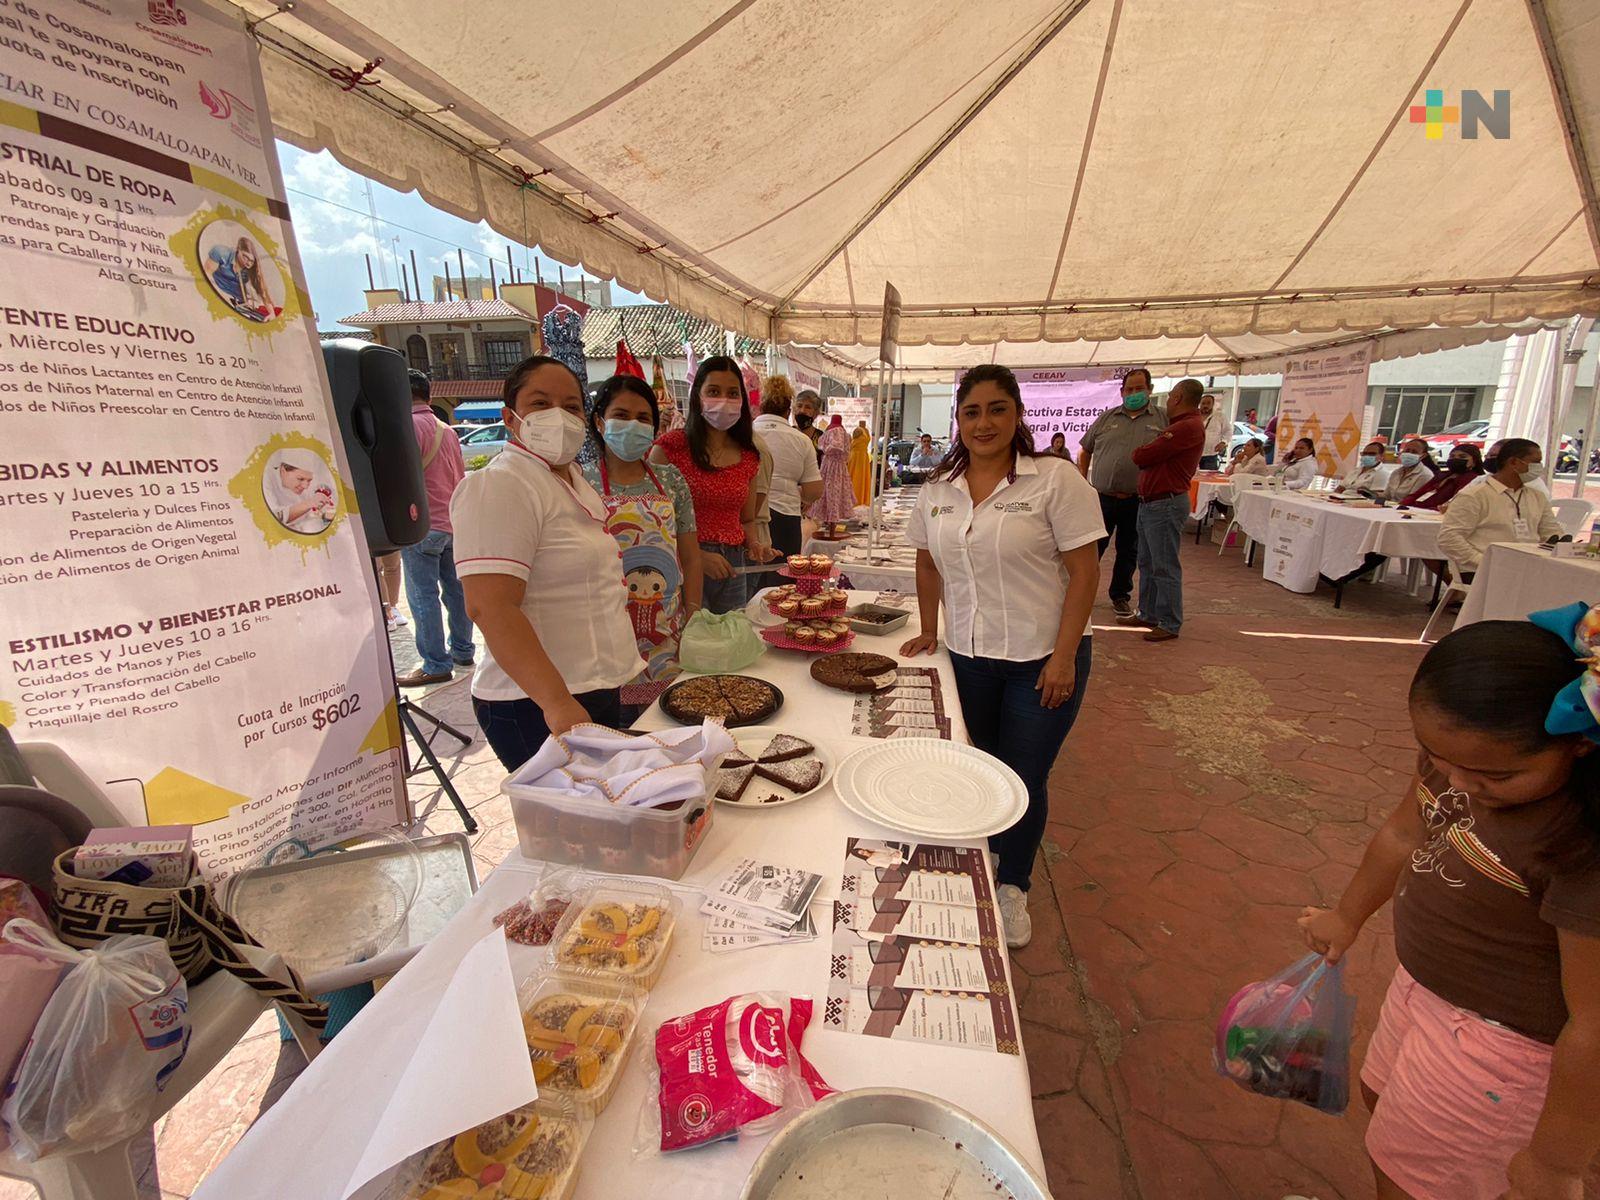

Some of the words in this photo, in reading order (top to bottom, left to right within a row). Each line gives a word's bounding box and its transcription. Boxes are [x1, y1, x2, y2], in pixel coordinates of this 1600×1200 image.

[15, 2, 40, 20] de
[46, 13, 185, 74] Cosamaloapan
[29, 25, 50, 43] te
[56, 39, 134, 73] apoyara
[138, 67, 170, 86] con
[52, 55, 77, 71] de
[52, 91, 80, 113] EN
[87, 104, 235, 175] COSAMALOAPAN,
[236, 162, 261, 188] VER.
[86, 164, 117, 188] DE
[120, 174, 177, 206] ROPA
[10, 193, 79, 220] Patronaje
[82, 213, 91, 224] y
[71, 187, 93, 205] 09
[100, 197, 109, 209] a
[115, 199, 135, 216] 15
[21, 236, 53, 252] para
[57, 241, 122, 265] Caballero
[125, 257, 133, 269] y
[55, 224, 86, 239] para
[89, 229, 128, 249] Dama
[130, 241, 138, 253] y
[140, 240, 170, 258] Niña
[98, 267, 125, 282] Alta
[128, 272, 178, 292] Costura
[74, 315, 196, 345] EDUCATIVO
[110, 344, 121, 359] y
[125, 343, 188, 363] Viernes
[196, 351, 214, 366] 16
[219, 357, 227, 367] a
[230, 355, 246, 370] 20
[20, 361, 39, 374] de
[43, 362, 88, 376] Niños
[91, 365, 154, 381] Lactantes
[158, 373, 173, 382] en
[176, 372, 218, 386] Centro
[220, 377, 233, 387] de
[273, 383, 303, 394] Infantil
[1032, 372, 1067, 380] CEEAIV
[24, 380, 43, 394] de
[48, 381, 92, 396] Niños
[95, 382, 155, 398] Maternal
[158, 390, 174, 399] en
[177, 388, 218, 402] Centro
[221, 392, 234, 402] de
[274, 397, 304, 408] Infantil
[28, 400, 48, 413] de
[51, 400, 96, 414] Niños
[100, 402, 168, 416] Preescolar
[172, 407, 187, 416] en
[190, 406, 231, 418] Centro
[233, 408, 246, 418] de
[283, 412, 316, 421] Infantil
[1052, 424, 1060, 433] a
[76, 461, 93, 478] Y
[101, 458, 219, 477] ALIMENTOS
[54, 491, 65, 506] y
[72, 486, 135, 502] Jueves
[139, 483, 161, 498] 10
[166, 486, 176, 496] a
[181, 481, 200, 495] 15
[72, 506, 140, 523] Pasteleria
[143, 508, 151, 519] y
[155, 503, 198, 516] Dulces
[200, 500, 231, 513] Finos
[157, 521, 173, 532] de
[175, 516, 234, 531] Alimentos
[30, 552, 50, 563] de
[53, 544, 127, 561] Alimentos
[131, 540, 148, 551] de
[151, 537, 196, 550] Origen
[196, 531, 237, 546] Vegetal
[34, 569, 54, 581] de
[57, 561, 131, 578] Alimentos
[135, 557, 152, 568] de
[155, 553, 199, 566] Origen
[201, 545, 240, 560] Animal
[8, 624, 132, 655] ESTILISMO
[138, 620, 153, 635] Y
[158, 599, 262, 632] BIENESTAR
[265, 583, 342, 610] PERSONAL
[12, 652, 94, 674] Martes
[100, 648, 112, 663] y
[118, 635, 185, 657] Jueves
[189, 627, 212, 644] 10
[217, 627, 226, 637] a
[232, 618, 252, 634] 16
[17, 669, 90, 688] Cuidados
[94, 665, 113, 676] de
[117, 658, 163, 673] Manos
[166, 655, 174, 666] y
[177, 649, 202, 662] Pies
[21, 688, 68, 703] Color
[72, 687, 81, 699] y
[193, 660, 211, 673] del
[214, 650, 257, 668] Cabello
[25, 704, 73, 718] Corte
[76, 702, 84, 712] y
[151, 685, 170, 698] del
[174, 674, 221, 693] Cabello
[29, 711, 102, 729] Maquillaje
[107, 706, 127, 719] del
[132, 700, 179, 716] Rostro
[237, 709, 274, 728] Cuota
[280, 701, 294, 716] de
[243, 728, 266, 748] por
[272, 714, 308, 736] Cursos
[312, 693, 362, 732] $602
[241, 793, 274, 814] Para
[276, 775, 320, 799] Mayor
[323, 756, 364, 782] Informe
[191, 837, 210, 848] En
[214, 830, 234, 843] las
[236, 797, 314, 836] Instalaciones
[317, 787, 335, 801] del
[337, 779, 353, 793] DIF
[308, 812, 331, 825] Ver.
[334, 806, 348, 816] en
[198, 847, 216, 859] C.
[219, 838, 251, 853] Pino
[253, 814, 288, 843] Suarez
[212, 870, 229, 884] de
[701, 1022, 718, 1079] Tenedor
